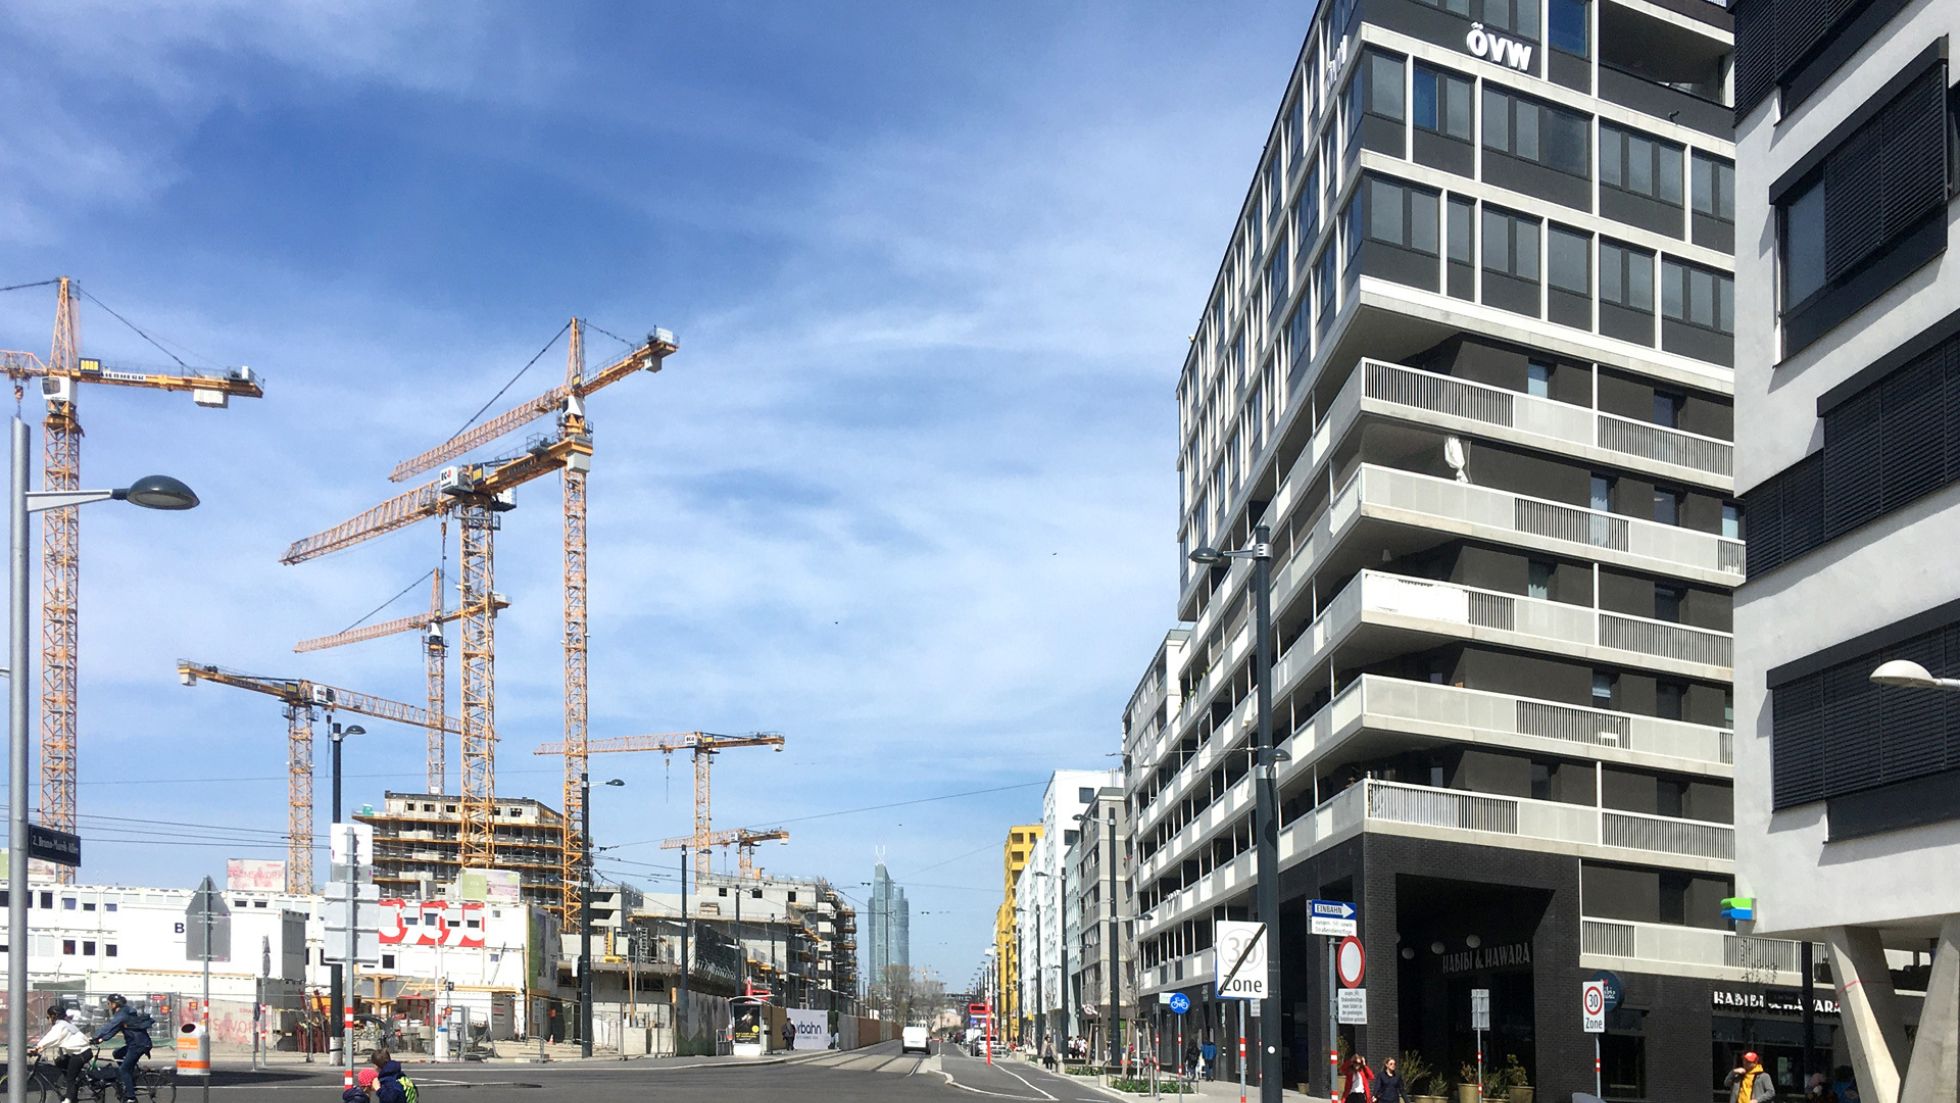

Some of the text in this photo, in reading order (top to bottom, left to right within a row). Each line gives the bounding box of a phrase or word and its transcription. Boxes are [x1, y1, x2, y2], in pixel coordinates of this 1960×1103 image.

[1466, 21, 1532, 71] ÖVW
[1316, 904, 1343, 914] EINBAHN
[1228, 936, 1257, 964] 30
[1442, 951, 1473, 974] HABIBI
[1485, 942, 1530, 968] HAWARA
[1222, 974, 1263, 993] Zone
[1588, 993, 1599, 1008] 30
[1713, 991, 1764, 1008] HABIBI
[1585, 1017, 1603, 1030] Zone
